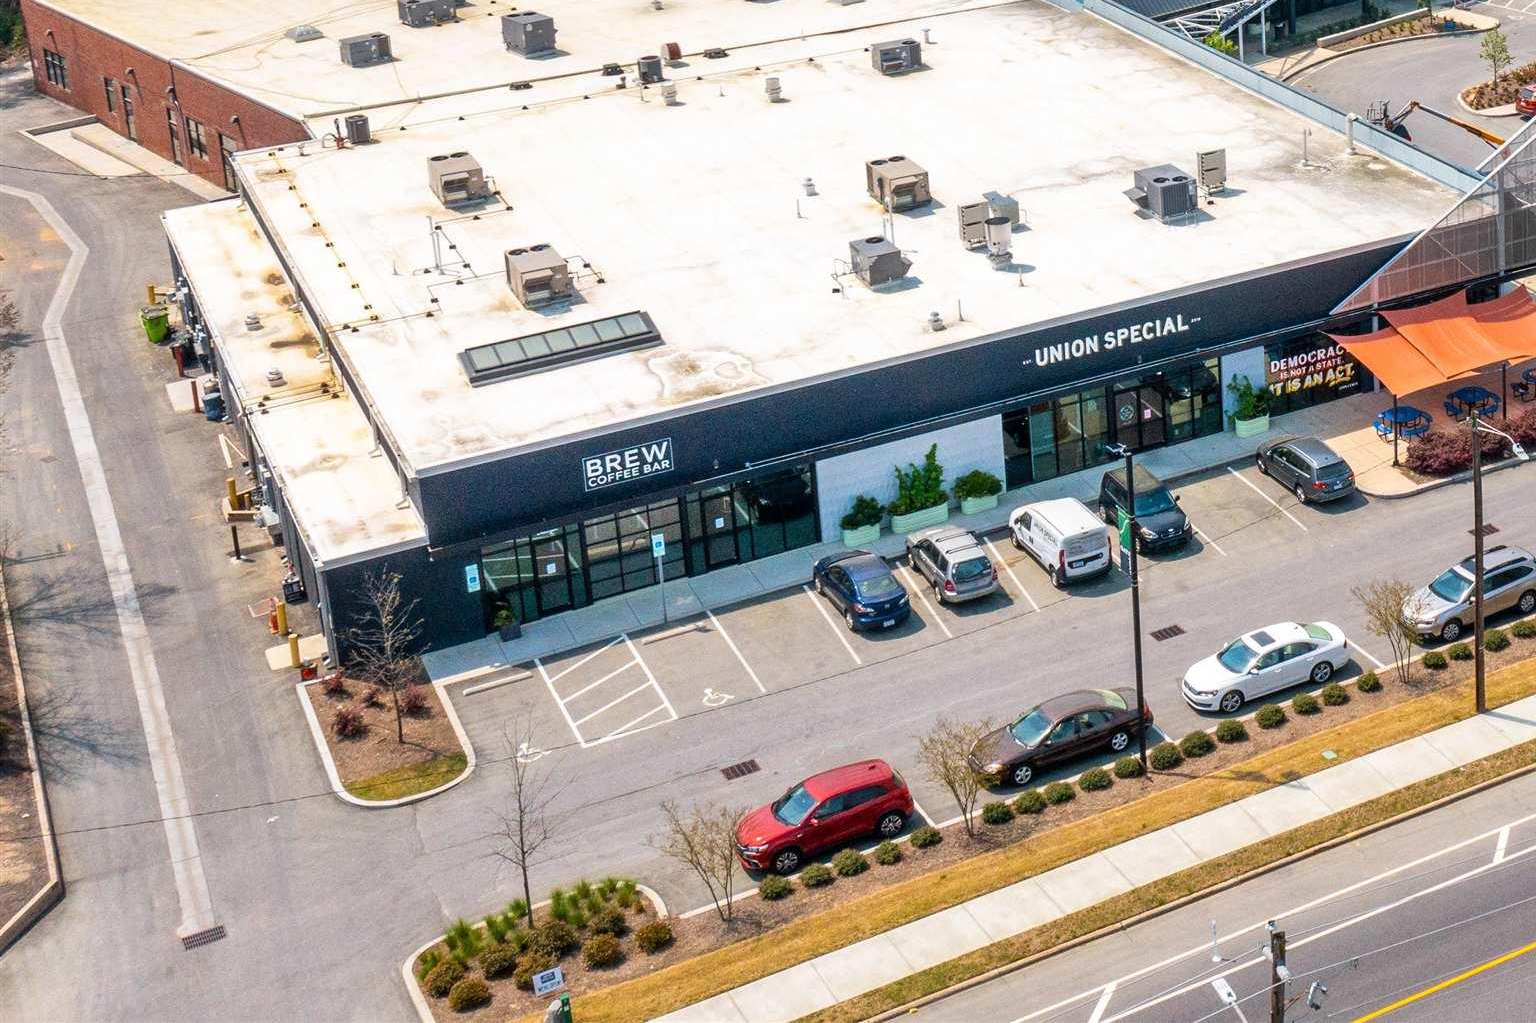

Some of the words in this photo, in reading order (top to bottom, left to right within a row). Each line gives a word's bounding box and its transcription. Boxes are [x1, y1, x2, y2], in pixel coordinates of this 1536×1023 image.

[1035, 335, 1099, 367] UNION
[1103, 313, 1189, 350] SPECIAL
[1270, 344, 1349, 373] DEMOCRAC
[1289, 366, 1307, 378] NOT
[1285, 378, 1301, 394] IS
[1303, 372, 1323, 389] AN
[586, 441, 668, 478] BREW
[588, 466, 640, 487] COFFEE
[643, 459, 670, 474] BAR
